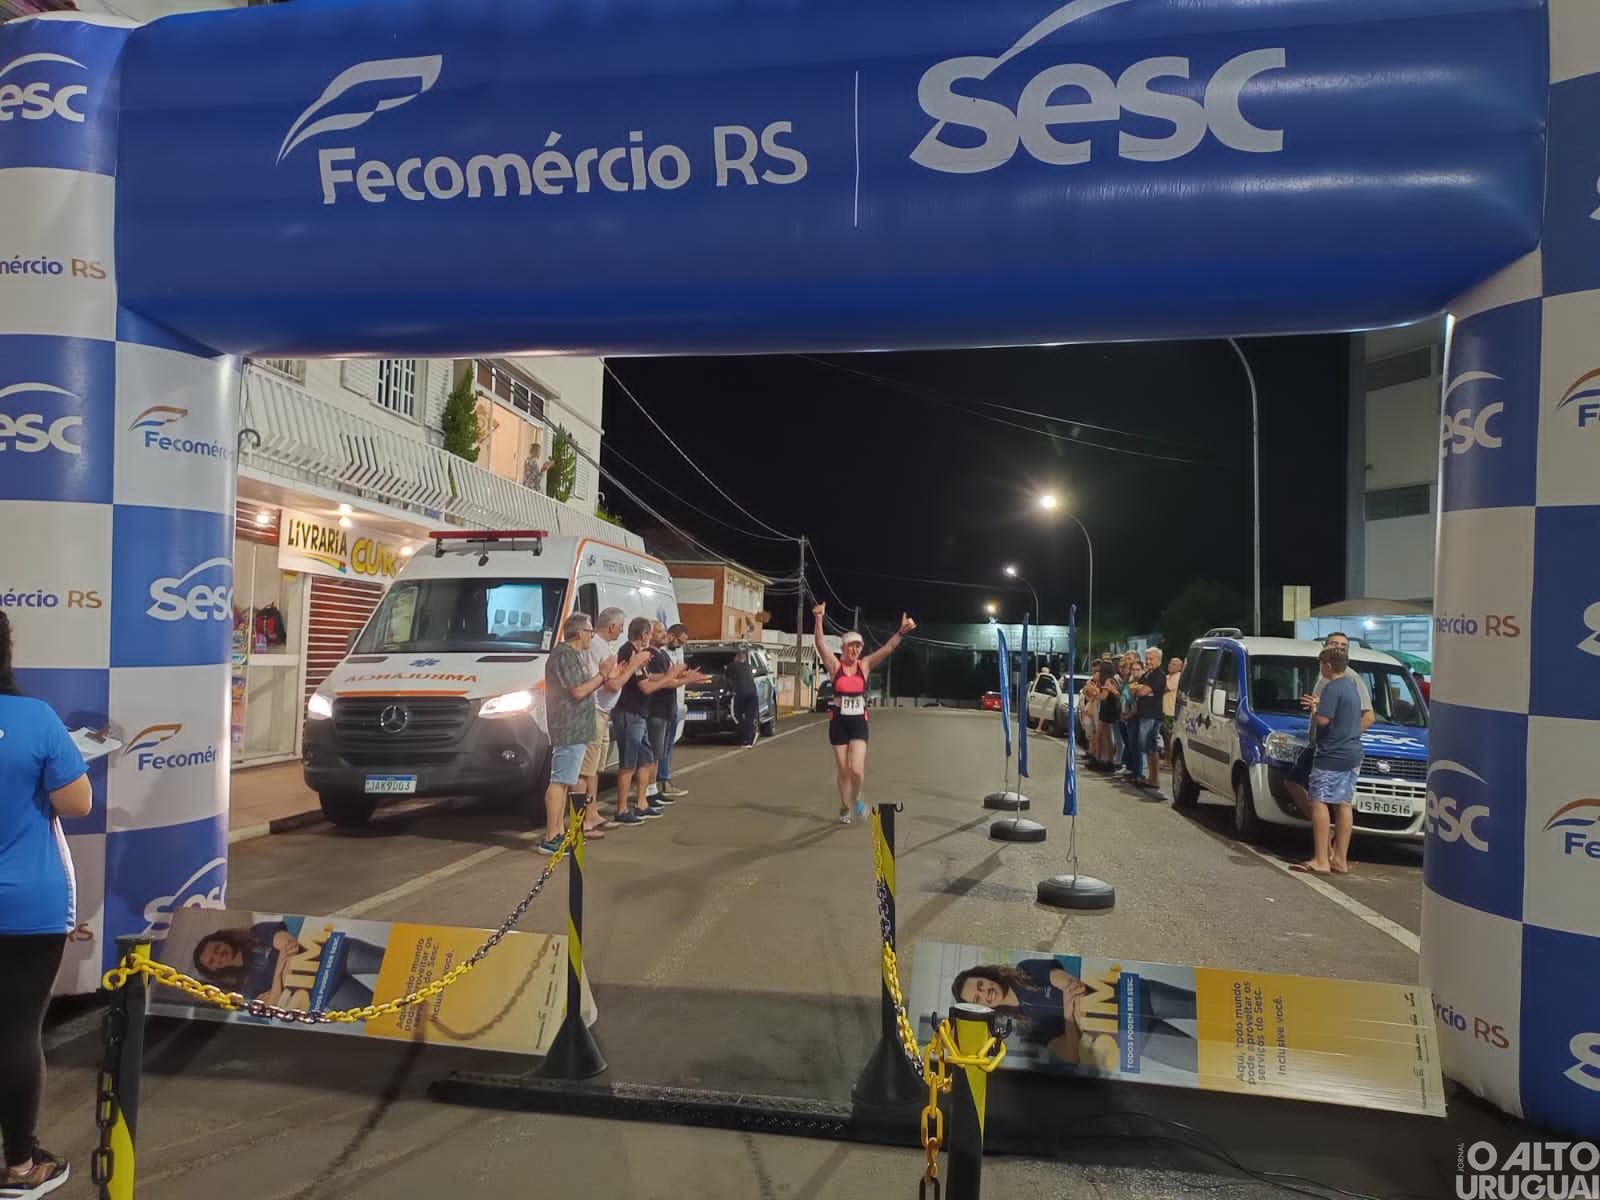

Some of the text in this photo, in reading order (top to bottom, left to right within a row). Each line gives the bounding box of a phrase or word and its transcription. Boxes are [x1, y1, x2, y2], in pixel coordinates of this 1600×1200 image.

[909, 48, 1287, 173] Sesc
[318, 120, 808, 204] Fecomércio RS
[71, 257, 107, 280] RS
[0, 587, 103, 609] ércio RS
[1484, 615, 1521, 637] RS
[1232, 982, 1242, 1018] mundo
[1244, 981, 1251, 993] os
[1254, 1016, 1263, 1031] do
[1474, 1017, 1509, 1049] RS
[1276, 1026, 1287, 1075] Inclusive
[1247, 1055, 1256, 1085] pode
